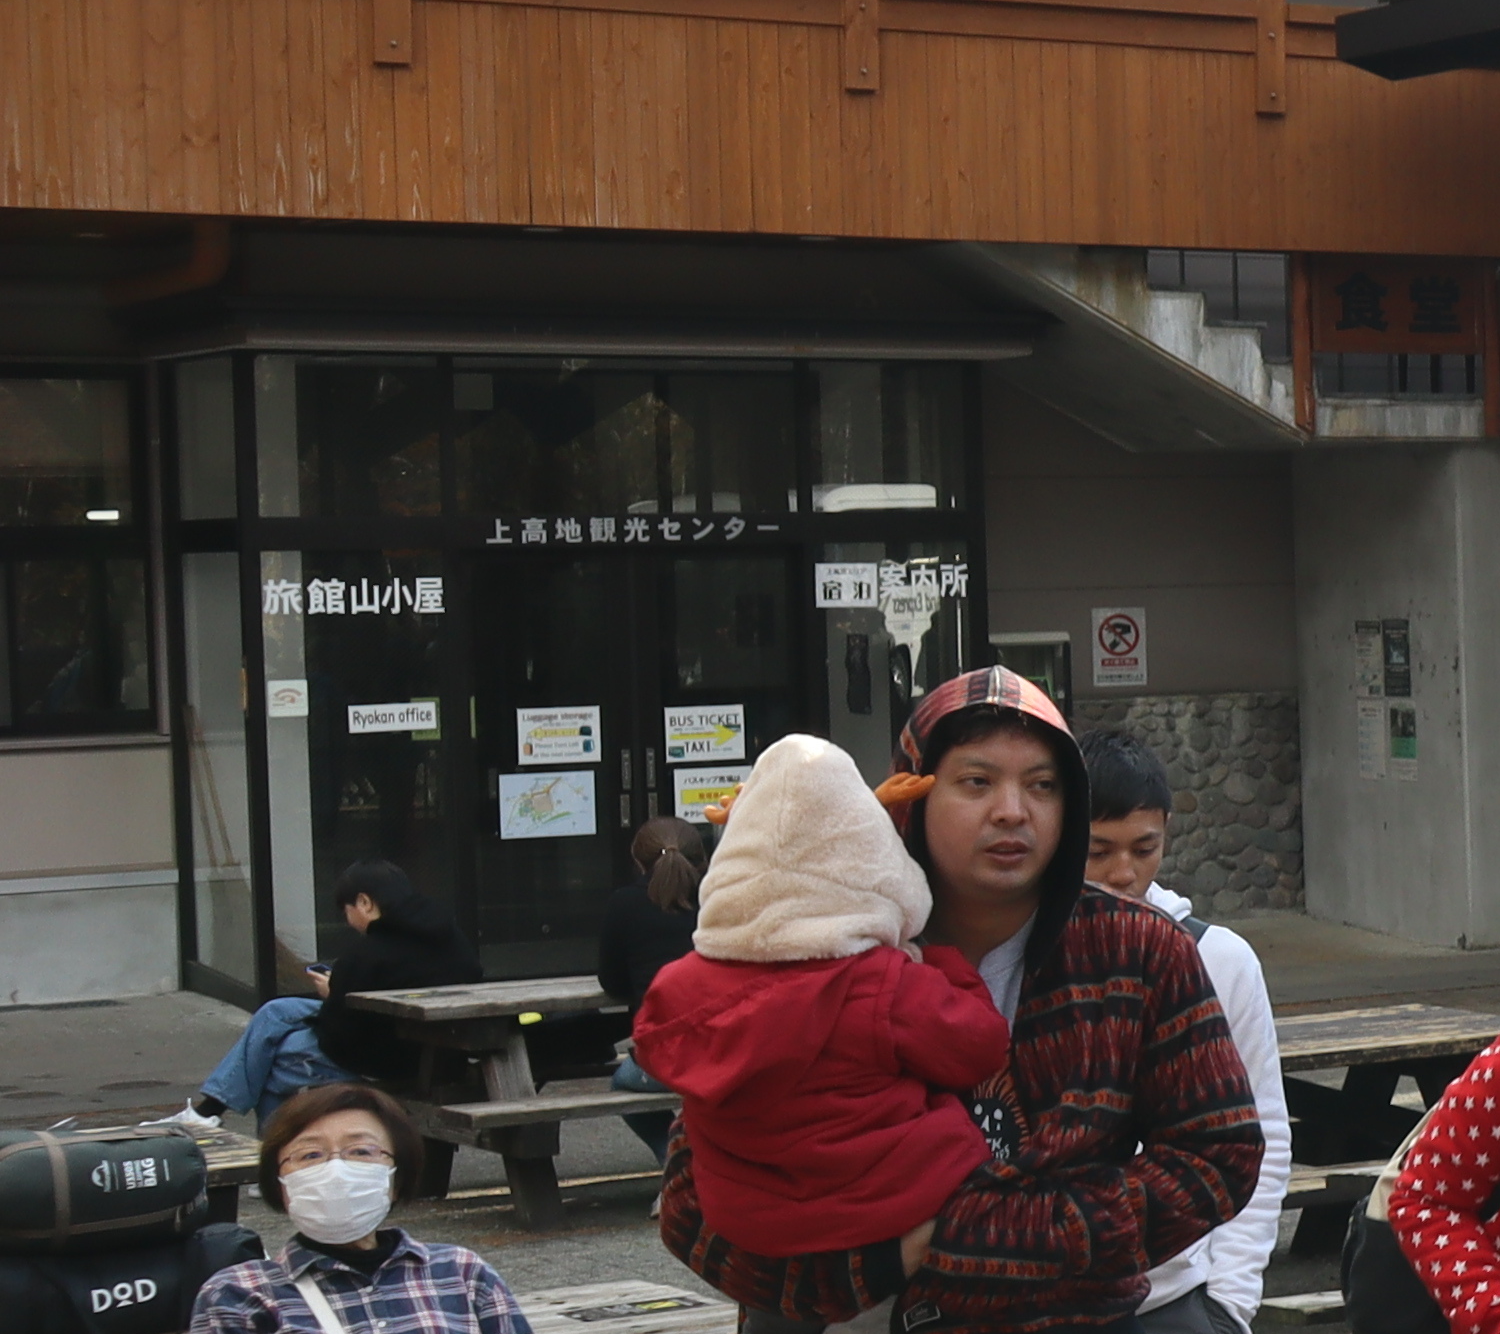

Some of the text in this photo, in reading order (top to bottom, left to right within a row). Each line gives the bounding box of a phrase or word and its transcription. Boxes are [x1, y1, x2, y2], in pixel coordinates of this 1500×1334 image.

[1334, 271, 1462, 333] 食堂
[485, 515, 781, 545] 上高地観光センター
[262, 575, 447, 617] 旅館山小屋
[822, 580, 871, 601] 宿泊
[878, 563, 969, 599] 案内所
[350, 705, 434, 728] Ryokan office
[522, 711, 594, 724] Luggage storage
[669, 712, 740, 728] BUS TICKET
[684, 740, 711, 754] TAXI
[140, 1157, 158, 1187] BAG
[91, 1278, 158, 1314] DOD
